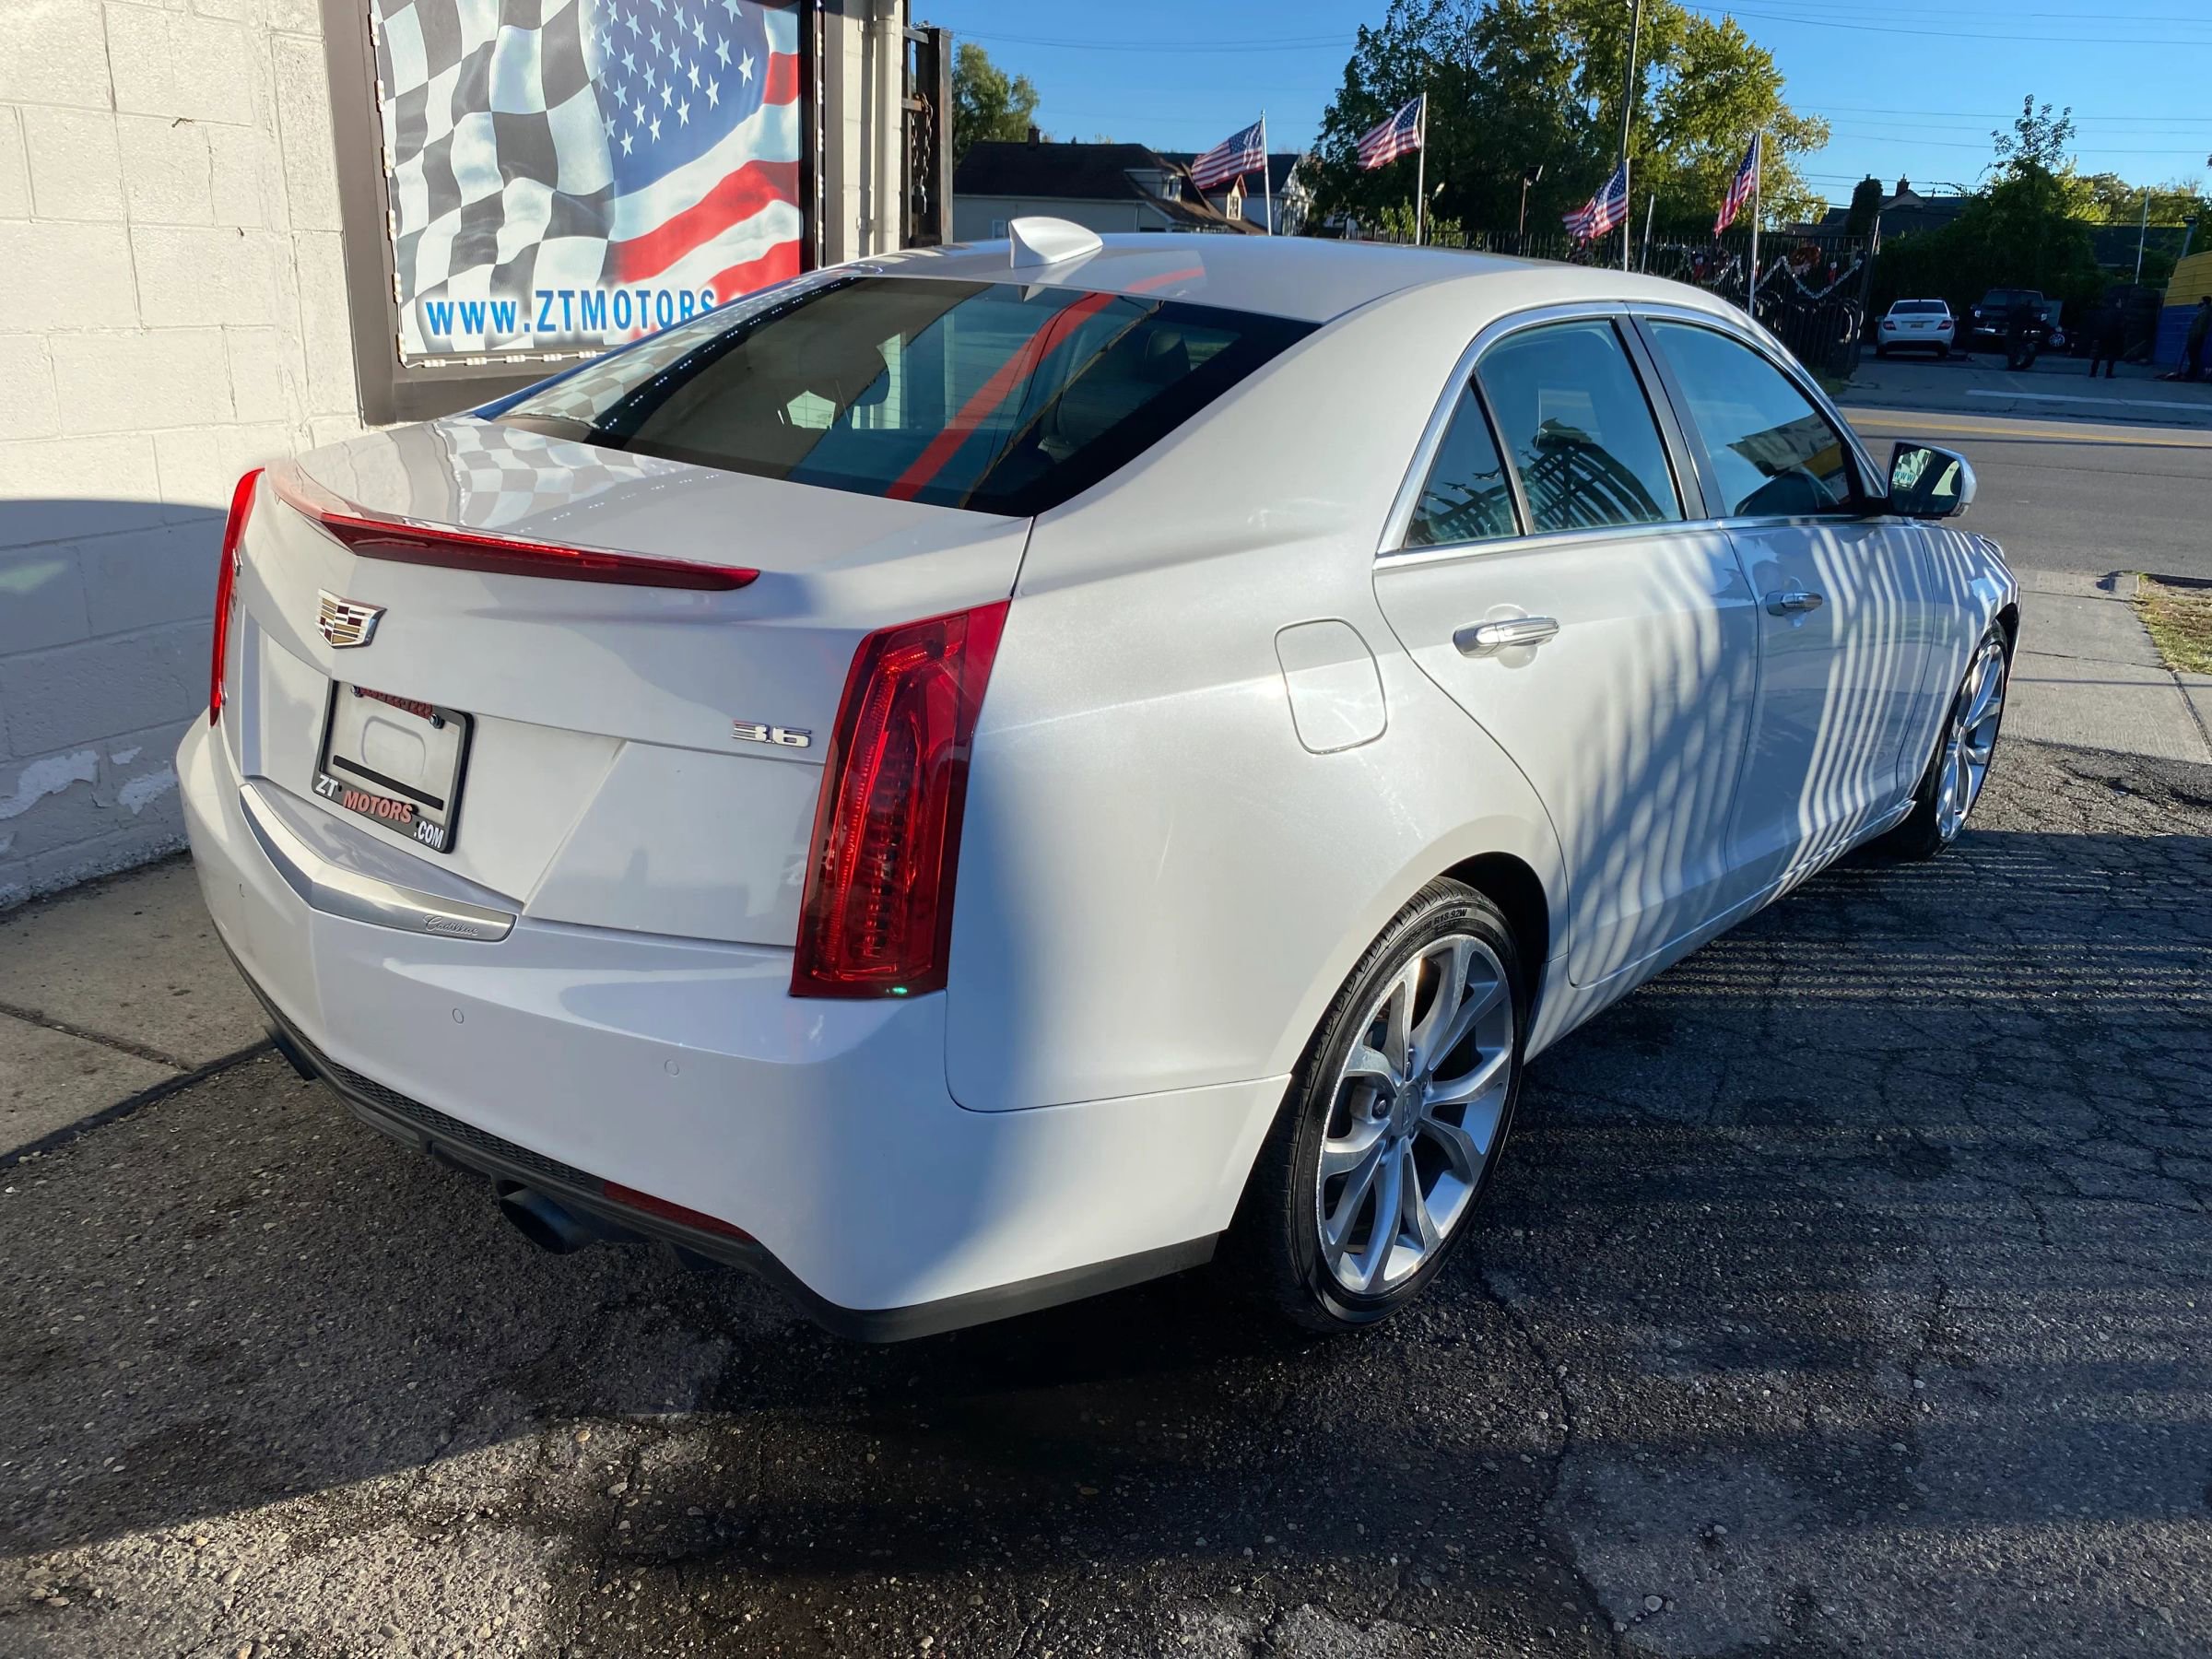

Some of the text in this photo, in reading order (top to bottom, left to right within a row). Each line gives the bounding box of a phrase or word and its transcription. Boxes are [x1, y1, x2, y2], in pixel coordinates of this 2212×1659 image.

[315, 774, 444, 848] ZT MOTORS .COM
[422, 914, 479, 936] Cadillac
